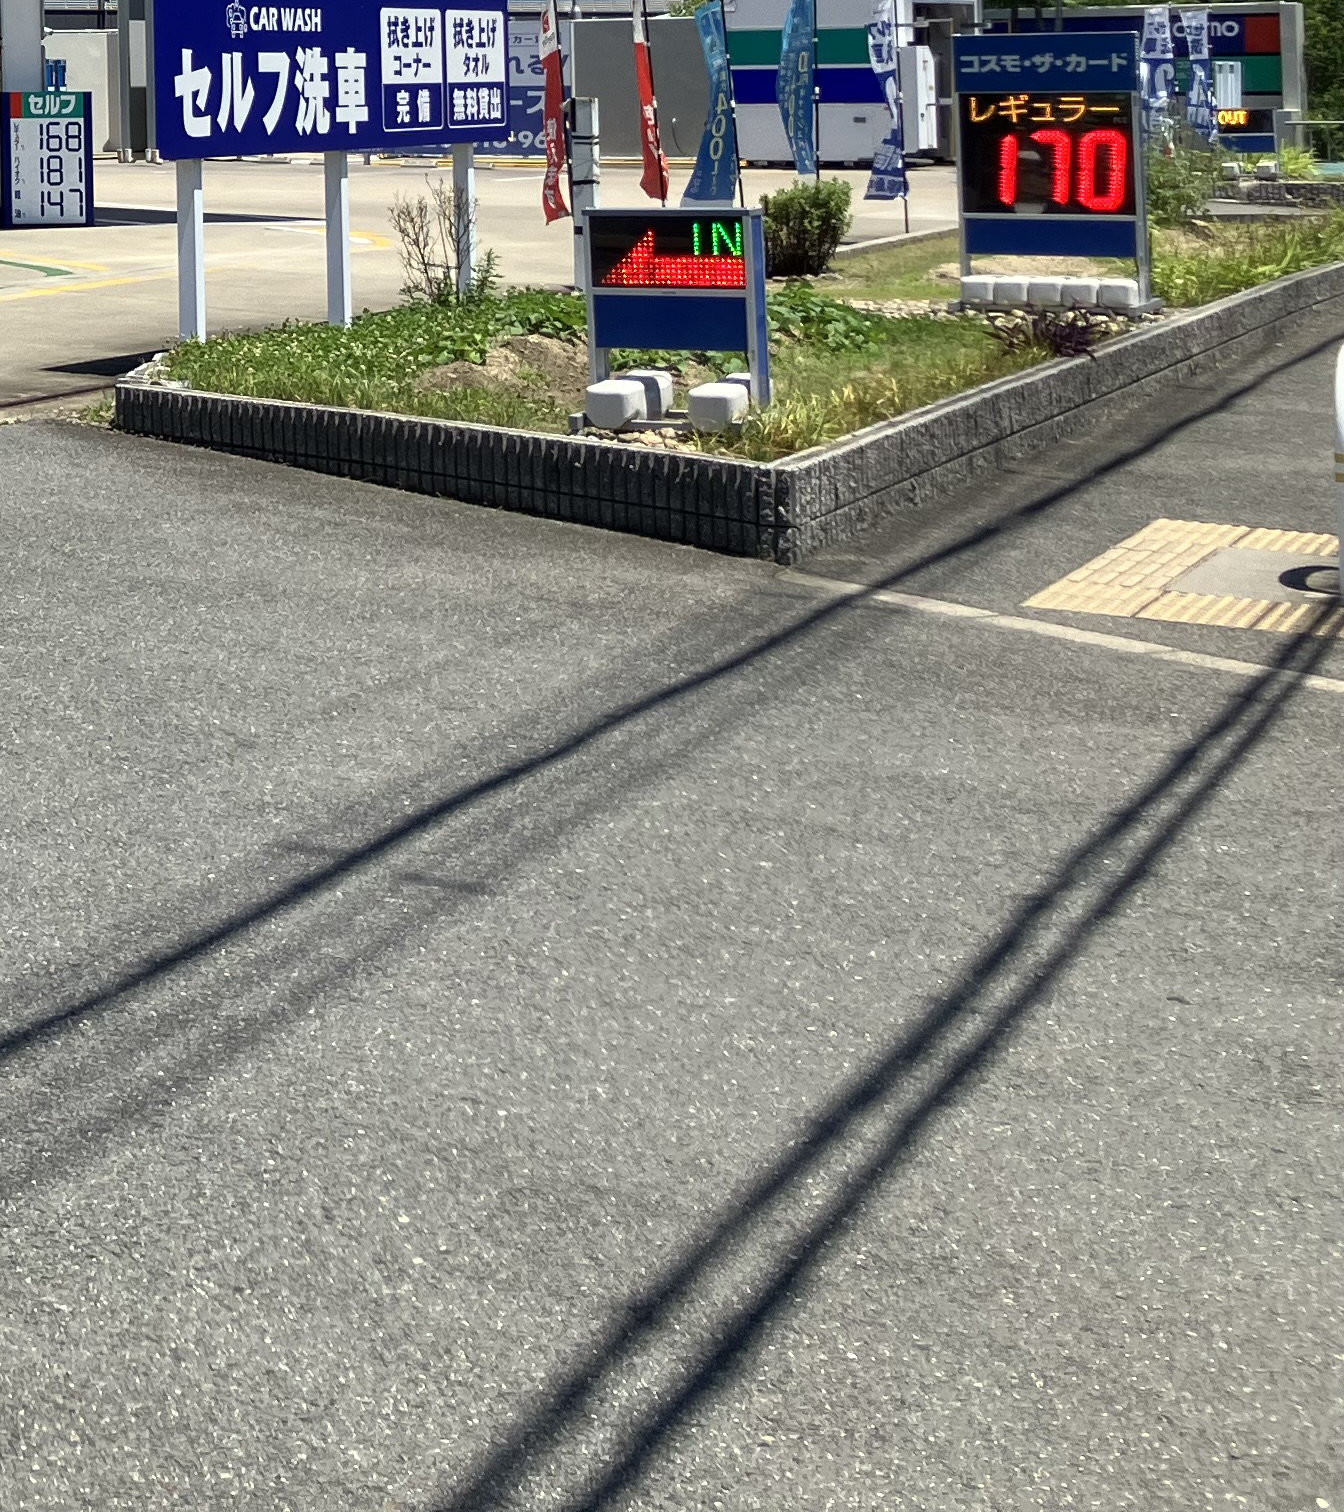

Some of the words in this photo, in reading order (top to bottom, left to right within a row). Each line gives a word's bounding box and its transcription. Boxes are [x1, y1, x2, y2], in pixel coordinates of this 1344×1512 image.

[249, 6, 278, 31] CAR
[280, 7, 322, 32] WASH
[387, 15, 436, 48] 拭き上げ
[452, 16, 497, 49] 拭き上げ
[393, 52, 432, 78] コーナー
[463, 52, 490, 78] タオル
[959, 52, 1128, 74] コスモ・ザ・カード
[28, 94, 76, 116] セルフ
[174, 45, 369, 138] セルフ洗車
[396, 88, 431, 124] 完備
[453, 87, 502, 121] 無料貸出
[968, 94, 1120, 123] レギュラー
[1217, 110, 1248, 125] OUT
[39, 122, 82, 152] 168
[39, 155, 83, 186] 181
[997, 129, 1127, 211] 170
[40, 189, 84, 217] 147
[692, 222, 742, 256] IN
